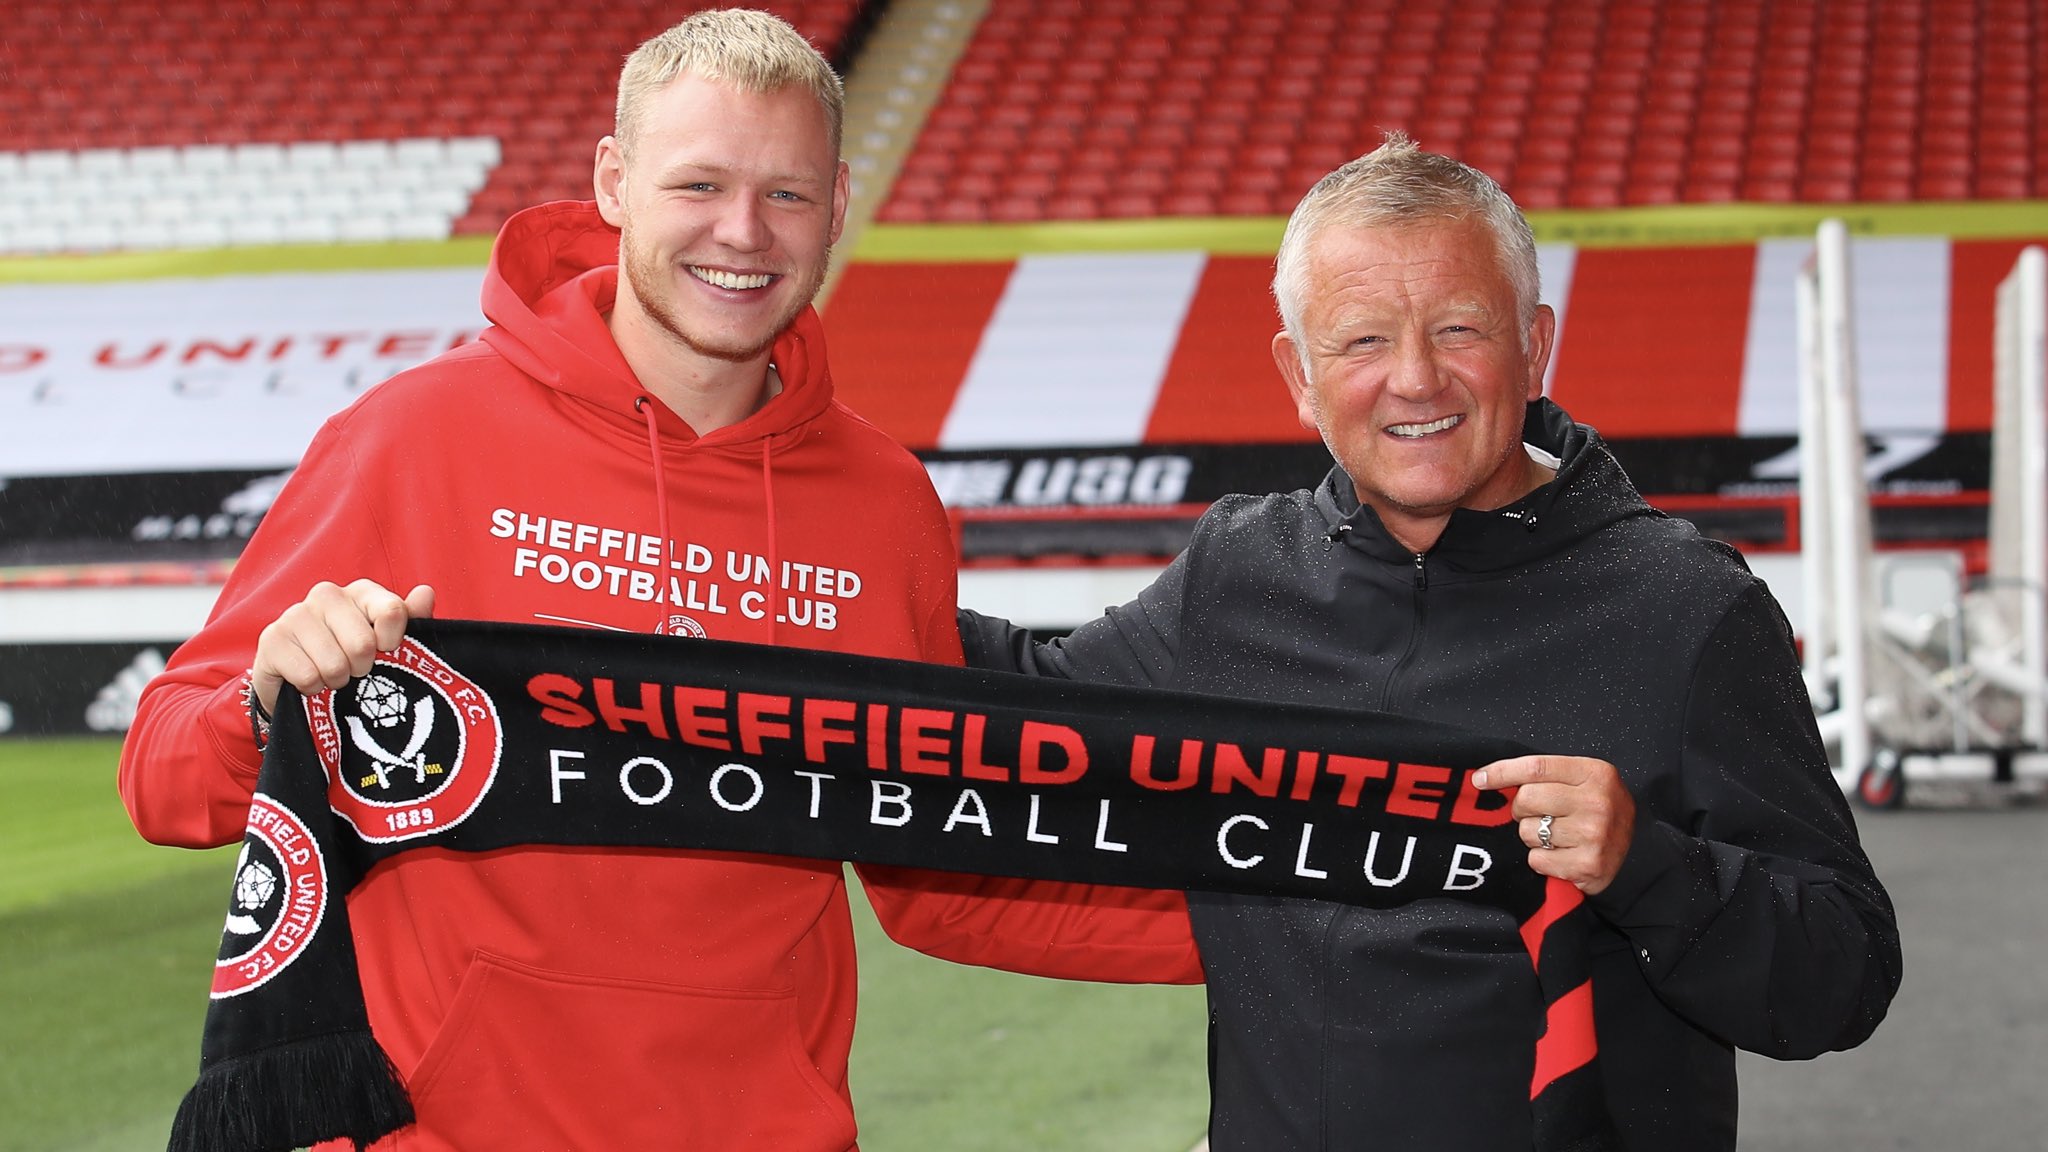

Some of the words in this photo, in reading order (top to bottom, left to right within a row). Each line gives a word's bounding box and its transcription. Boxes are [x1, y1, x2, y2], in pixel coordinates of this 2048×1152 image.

[93, 328, 478, 371] UNITE
[513, 547, 728, 615] FOOTBALL
[726, 550, 862, 599] UNITED
[526, 672, 1090, 786] SHEFFIELD
[1129, 733, 1521, 828] UNITED
[249, 804, 311, 866] EFFIELD
[385, 807, 435, 832] 1889
[549, 748, 1129, 853] FOOTBALL
[1216, 813, 1494, 891] CLUB
[273, 872, 316, 953] UNITED
[238, 951, 276, 979] F.C.
